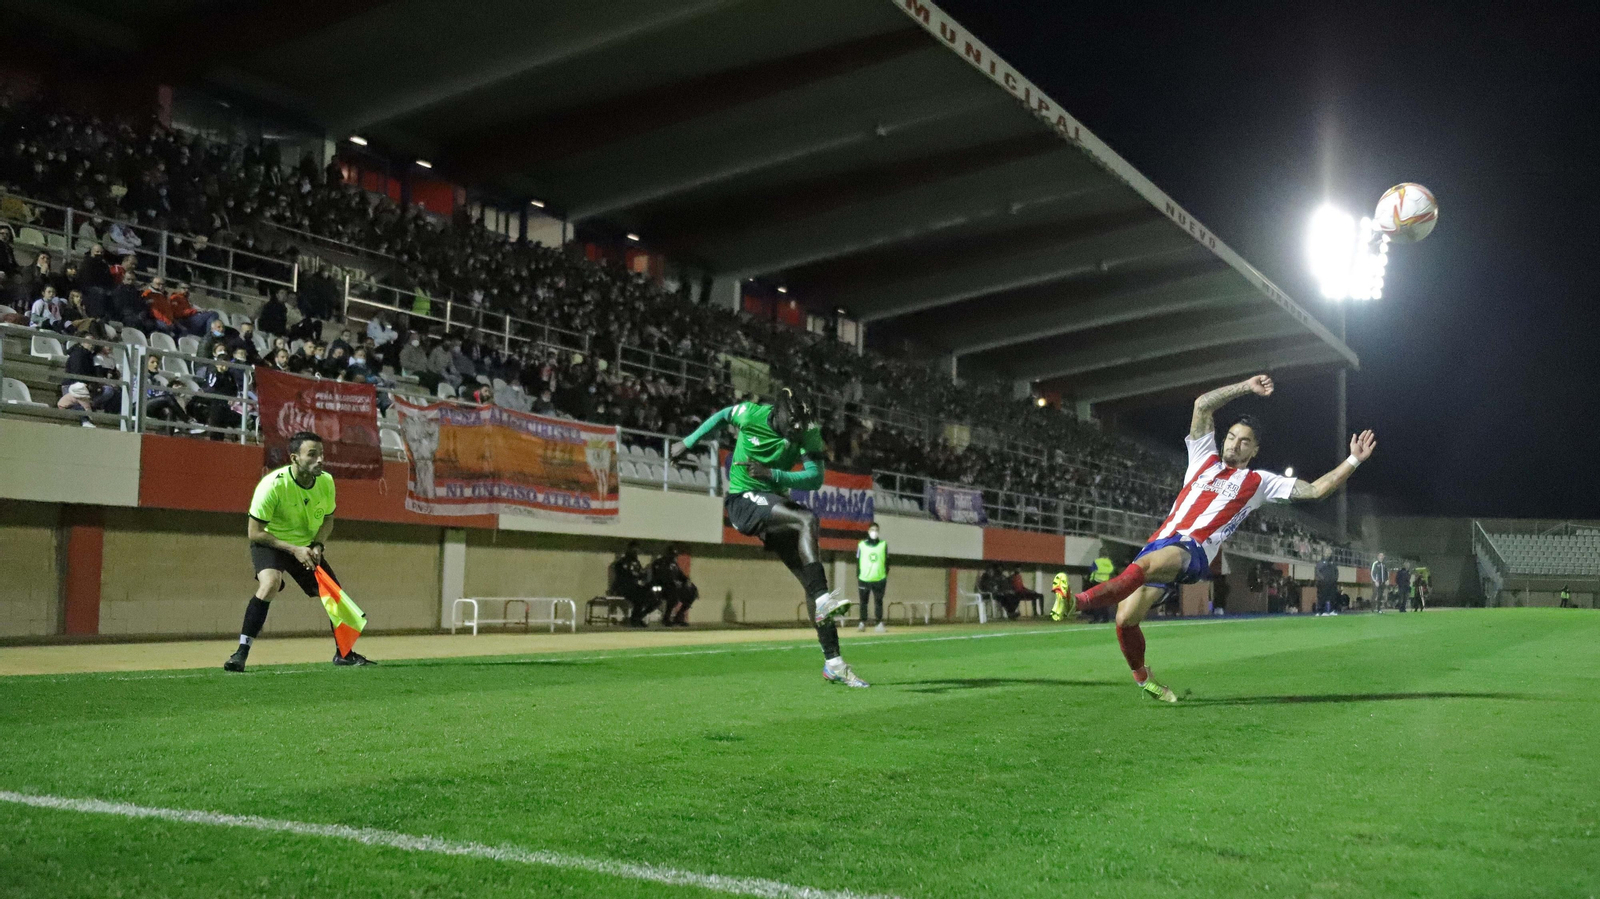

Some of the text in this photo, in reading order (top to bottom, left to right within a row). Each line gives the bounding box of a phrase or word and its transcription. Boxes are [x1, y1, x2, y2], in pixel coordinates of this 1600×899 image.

[905, 0, 1082, 143] MUNICIPAL
[1165, 202, 1216, 249] NUEVO
[446, 483, 465, 498] NI
[497, 483, 538, 502] PASO
